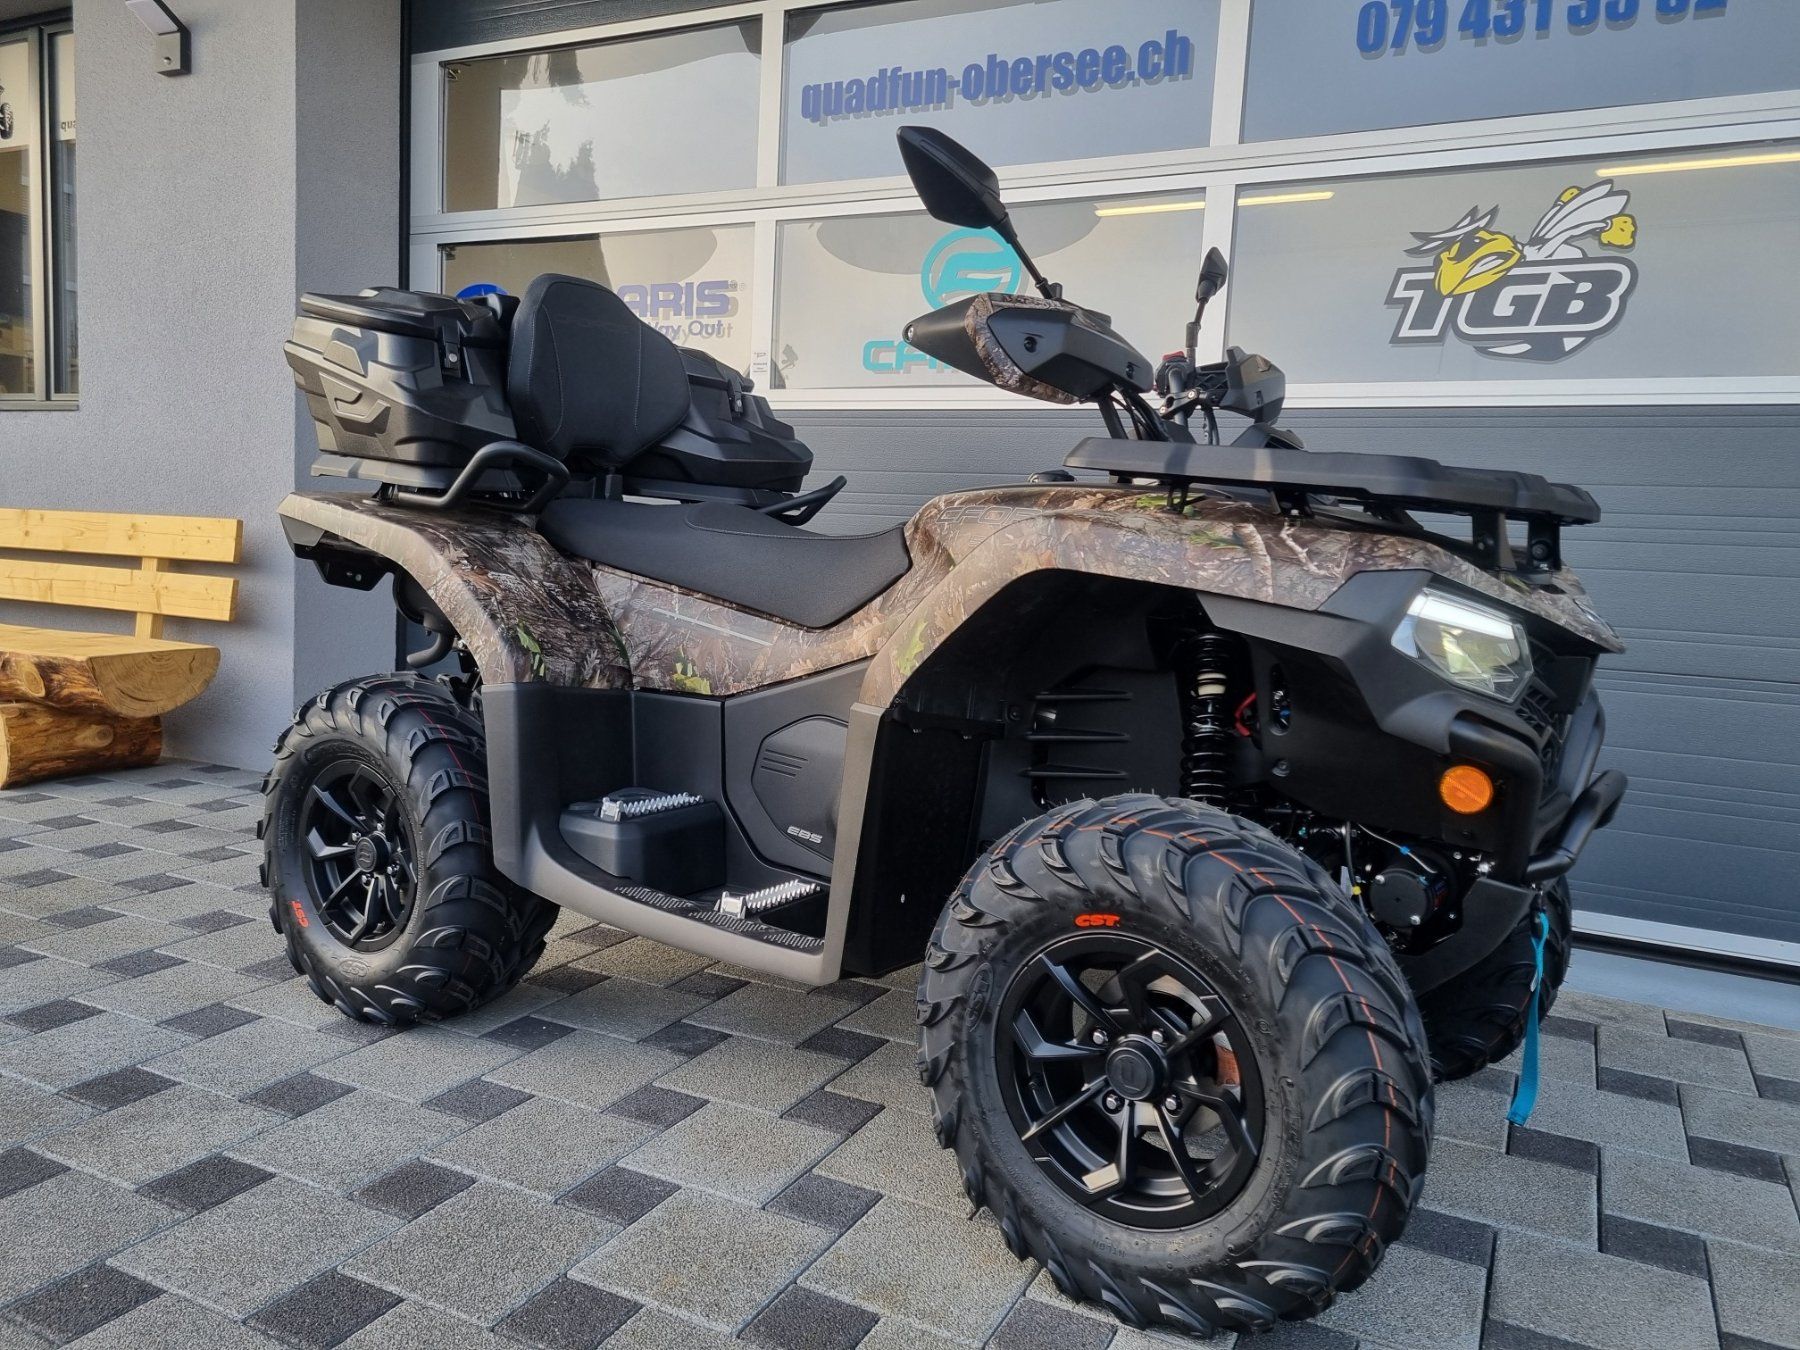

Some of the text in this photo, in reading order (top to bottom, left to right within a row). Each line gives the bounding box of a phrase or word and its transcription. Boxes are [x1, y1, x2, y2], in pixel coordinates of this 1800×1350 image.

[801, 29, 1191, 122] quadfun-obersee.ch
[1386, 256, 1637, 344] TGB
[688, 320, 723, 336] Out
[1075, 914, 1120, 927] CST
